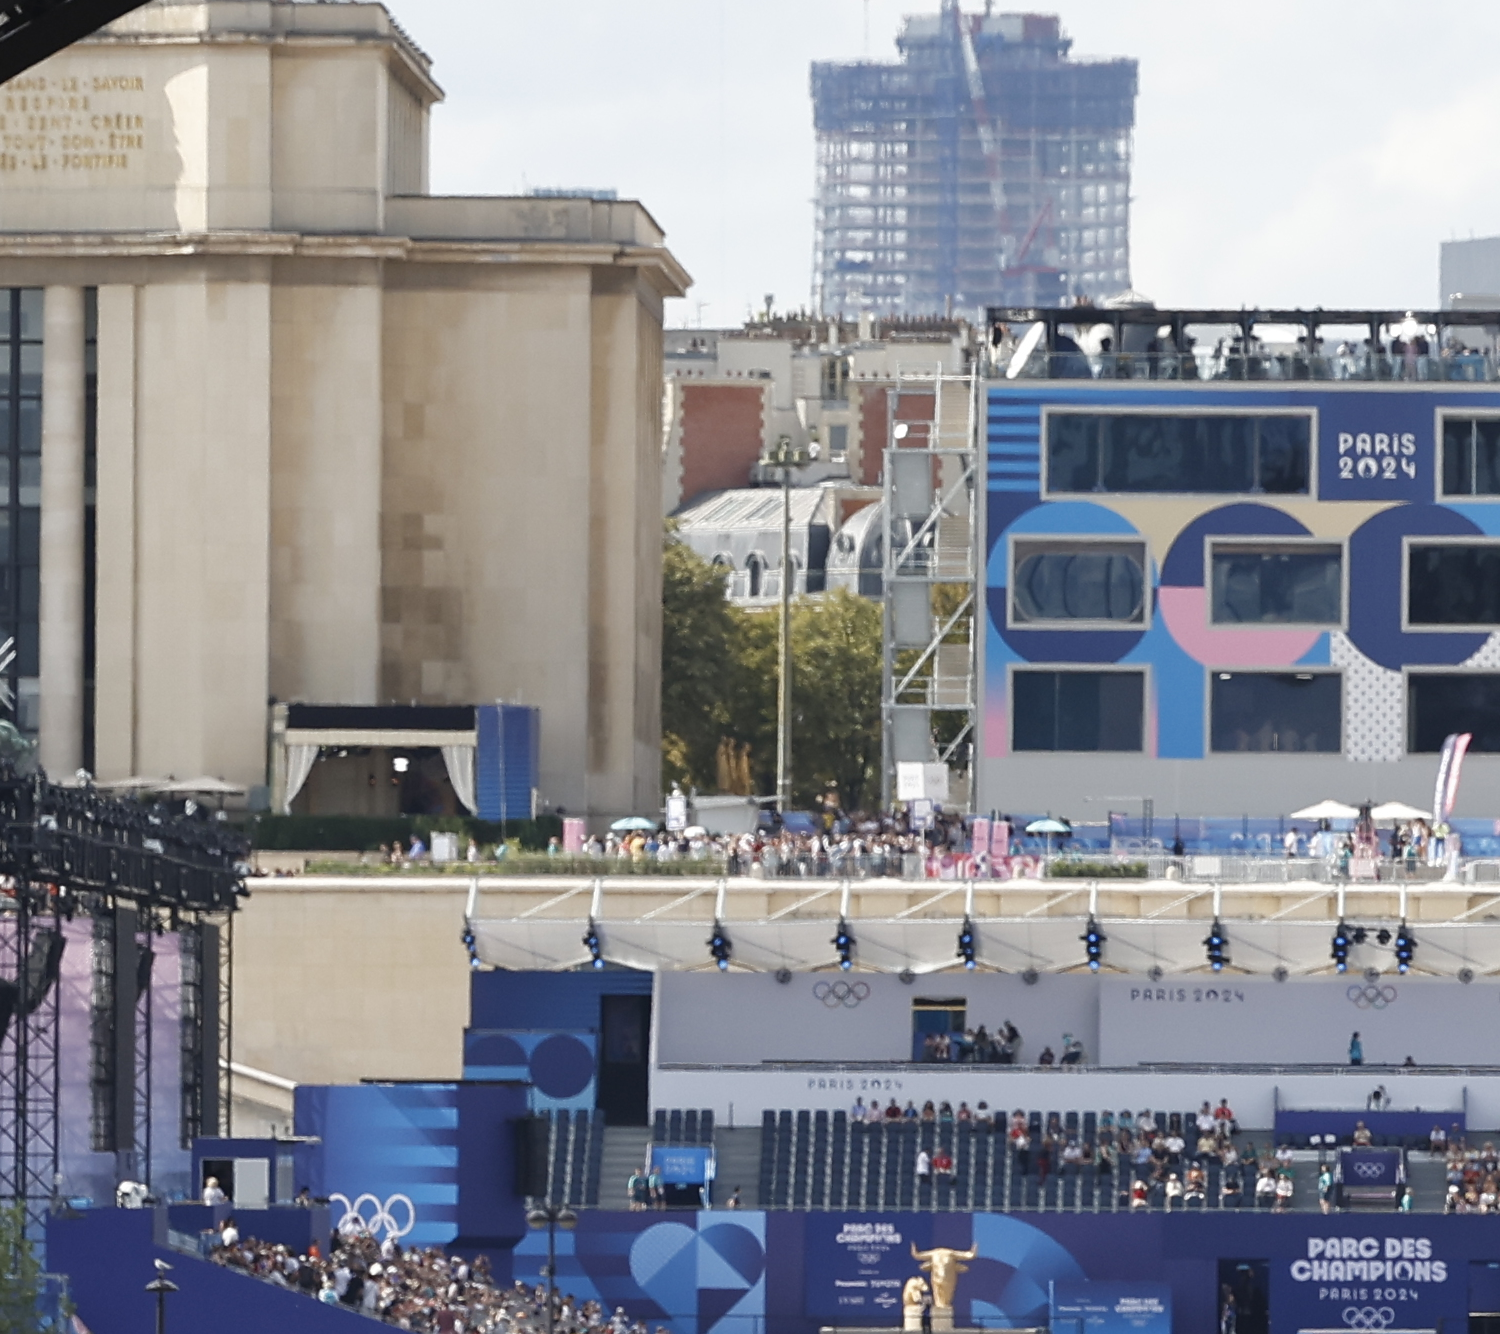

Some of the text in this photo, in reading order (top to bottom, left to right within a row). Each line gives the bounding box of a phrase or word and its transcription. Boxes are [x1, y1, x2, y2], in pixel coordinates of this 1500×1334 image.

[94, 76, 144, 91] SAVOIR
[1338, 456, 1417, 479] 2024
[1130, 988, 1244, 1003] PARIS 2024
[1307, 1237, 1432, 1259] PARC DES
[1289, 1259, 1448, 1283] CHAMPIONS
[1318, 1287, 1419, 1301] PARIS 2024
